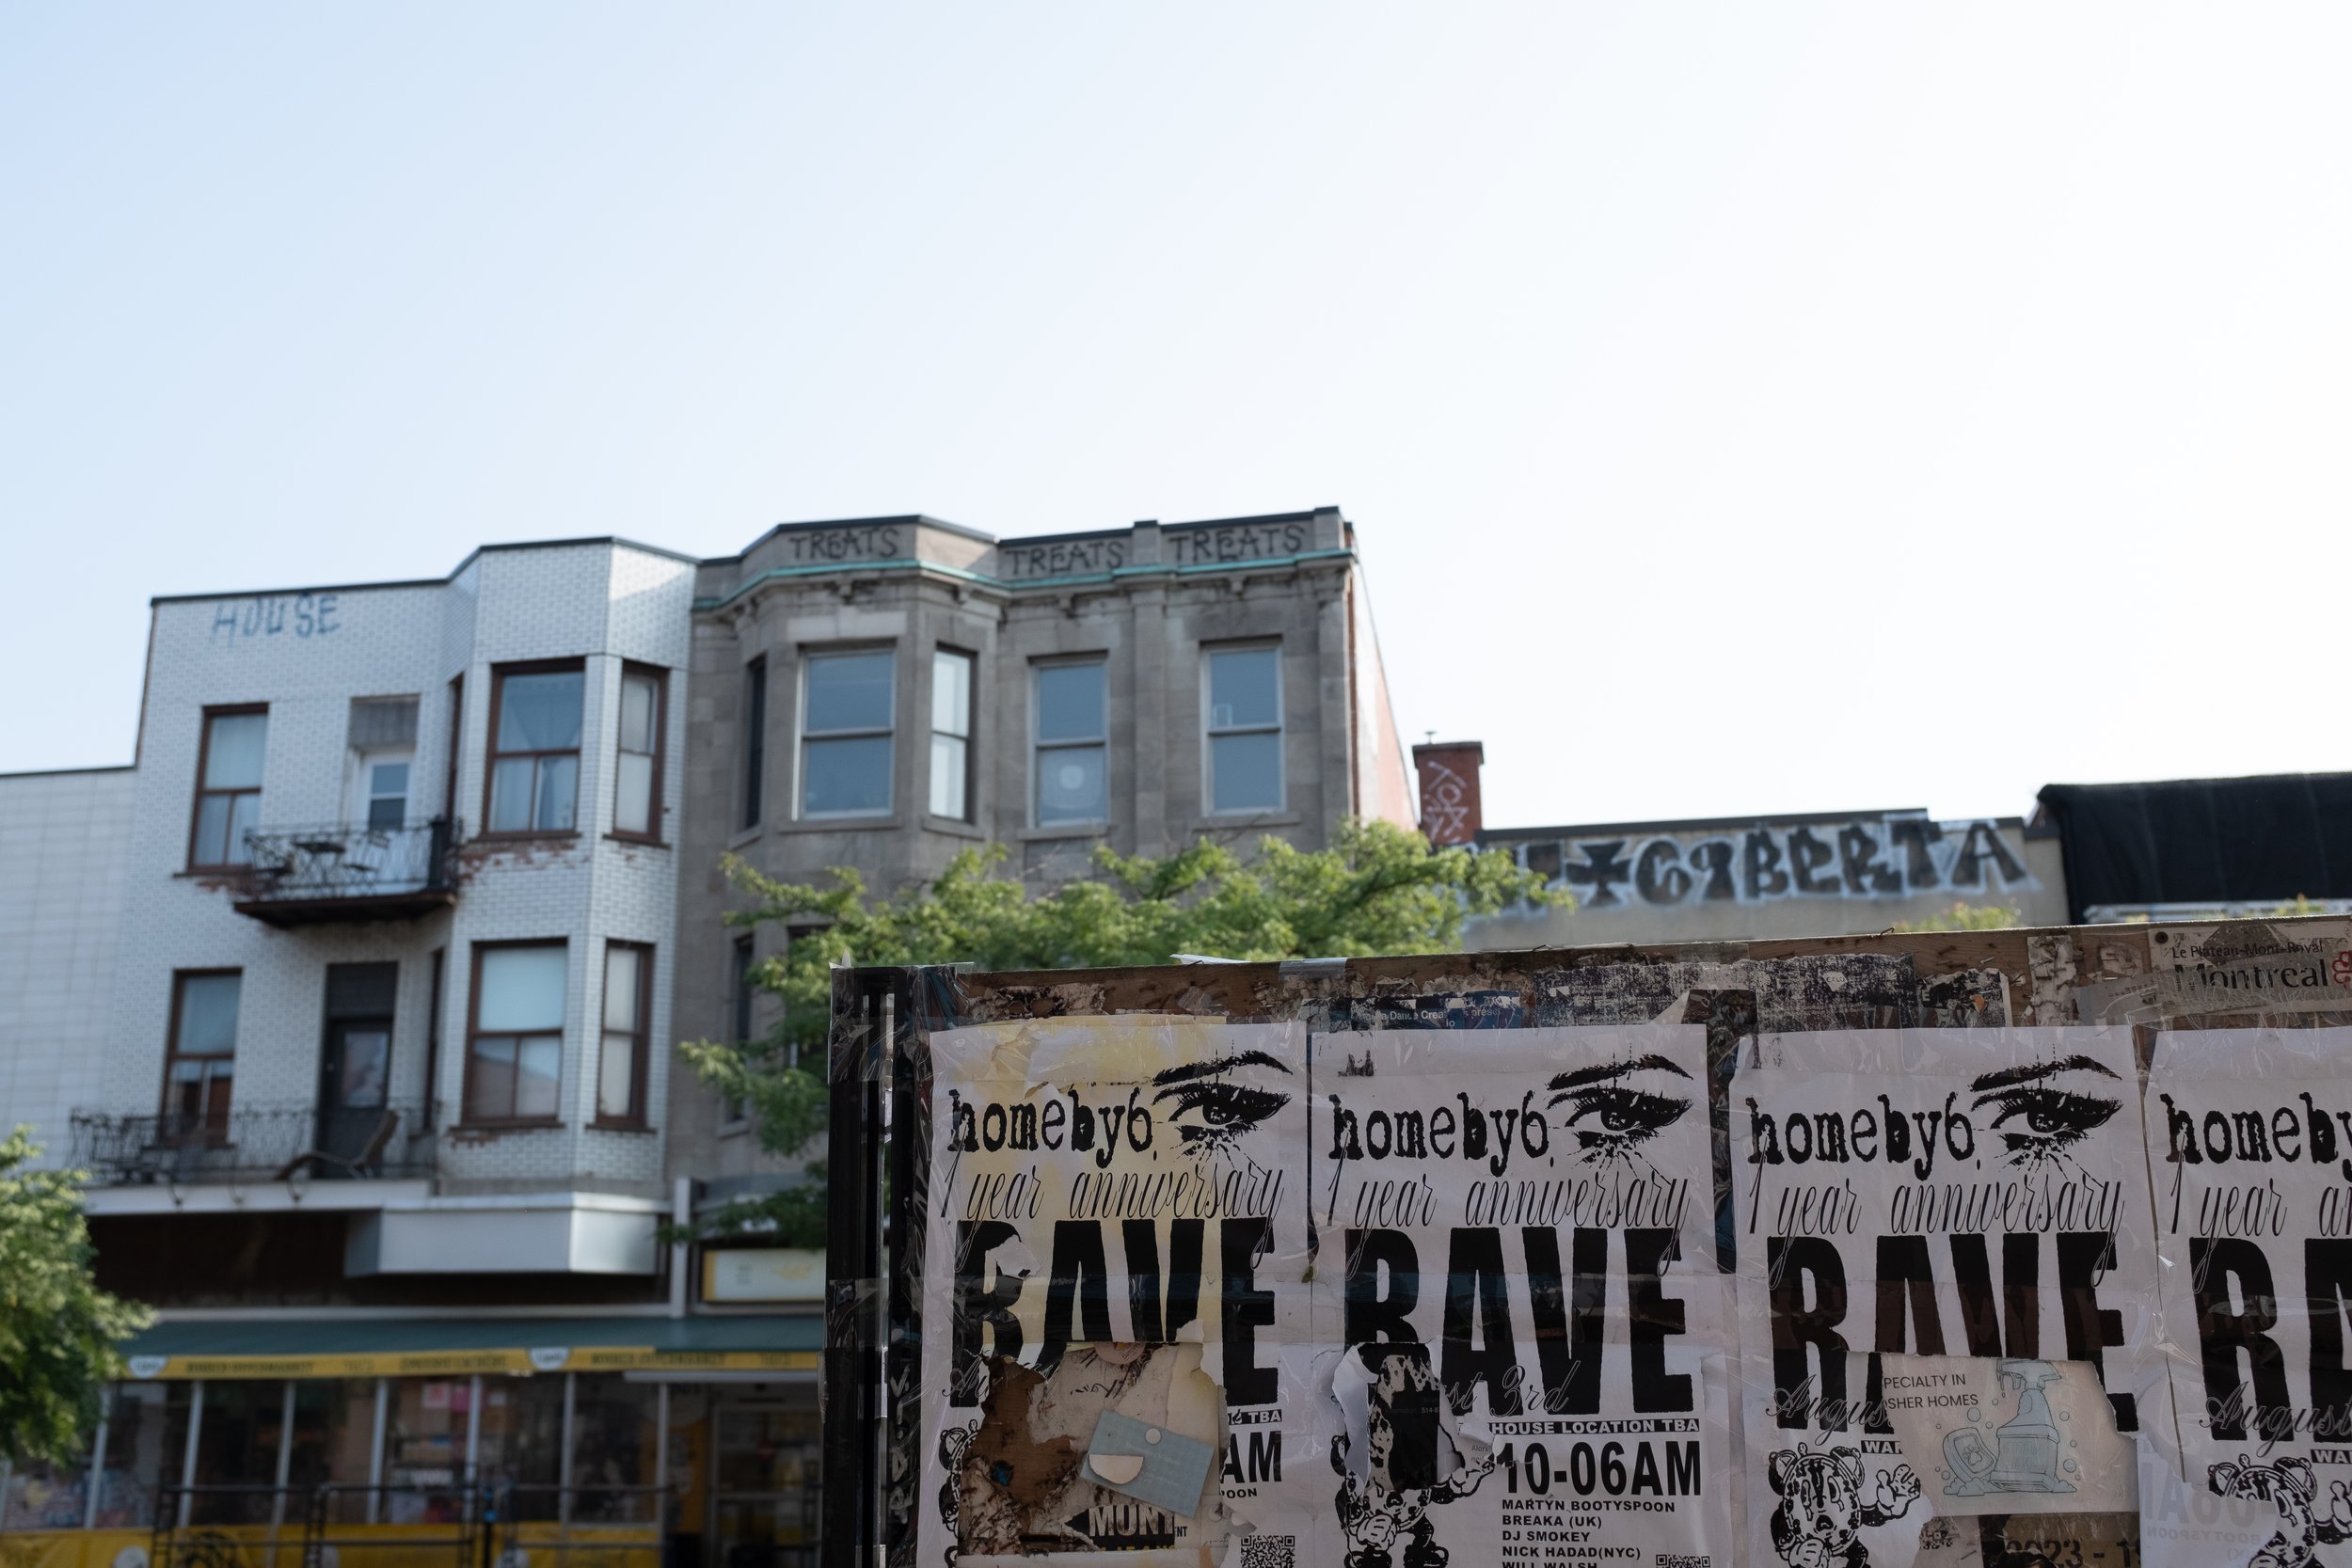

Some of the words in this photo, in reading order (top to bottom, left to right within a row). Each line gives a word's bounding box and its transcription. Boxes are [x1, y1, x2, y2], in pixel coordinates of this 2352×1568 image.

[789, 526, 900, 561] TREATS
[1004, 540, 1126, 577] TREATS
[1168, 524, 1307, 562] TREATS
[211, 593, 341, 645] HOUSE
[955, 1165, 1044, 1274] year
[1069, 1164, 1284, 1271] anniversary
[1345, 1173, 1438, 1280] year
[1466, 1171, 1690, 1276] anniversary
[1768, 1178, 1862, 1291] year
[1891, 1174, 2124, 1287] anniversary
[2192, 1178, 2287, 1293] year
[1343, 1226, 1693, 1415] RAVE
[1767, 1231, 2139, 1434] RAVE
[1490, 1360, 1581, 1418] 3rd
[1952, 1374, 1966, 1386] IN
[1248, 1410, 1281, 1423] TBA
[1765, 1374, 1895, 1446] Augus
[1884, 1397, 1923, 1409] SHER
[1928, 1394, 1979, 1407] HOMES
[1562, 1419, 1658, 1434] LOCATION
[1661, 1418, 1700, 1433] TBA
[1504, 1440, 1702, 1497] 10-06AM
[1502, 1499, 1565, 1512] MARTYN
[1570, 1500, 1676, 1513] BOOTYSPOON
[1502, 1514, 1564, 1528] BREAKA
[1568, 1515, 1602, 1529] (UK)
[1502, 1530, 1521, 1543] DJ
[1526, 1530, 1591, 1543] SMOKEY
[1502, 1546, 1540, 1558] NICK
[1545, 1546, 1642, 1560] HADAD(NYC)
